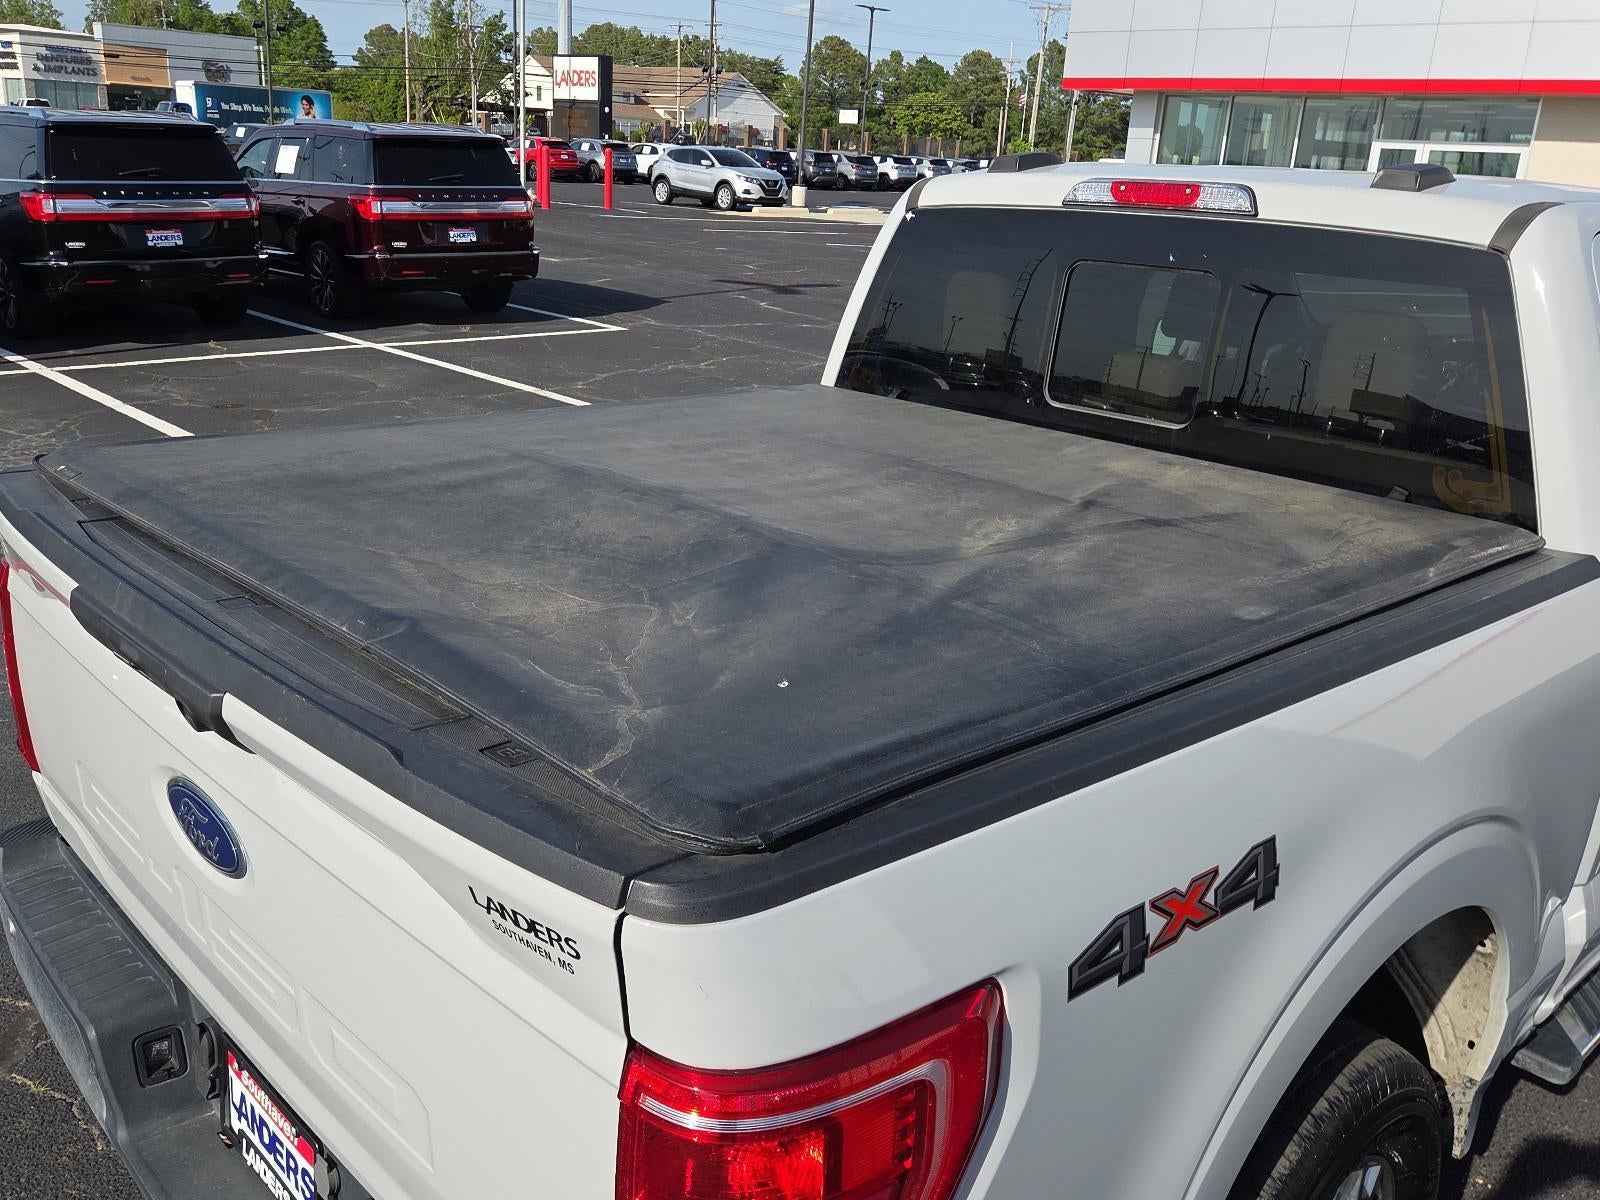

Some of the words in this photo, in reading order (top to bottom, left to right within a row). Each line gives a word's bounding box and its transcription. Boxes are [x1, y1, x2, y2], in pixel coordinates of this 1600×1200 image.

[32, 63, 40, 72] &
[44, 64, 98, 76] IMPLANTS
[555, 69, 597, 88] LANDERS
[147, 234, 182, 242] LANDERS
[179, 798, 219, 861] Ford
[468, 885, 581, 960] LANDERS
[492, 919, 556, 967] SOUTHAVEN,
[558, 957, 575, 975] MS
[230, 1076, 317, 1200] LANDERS
